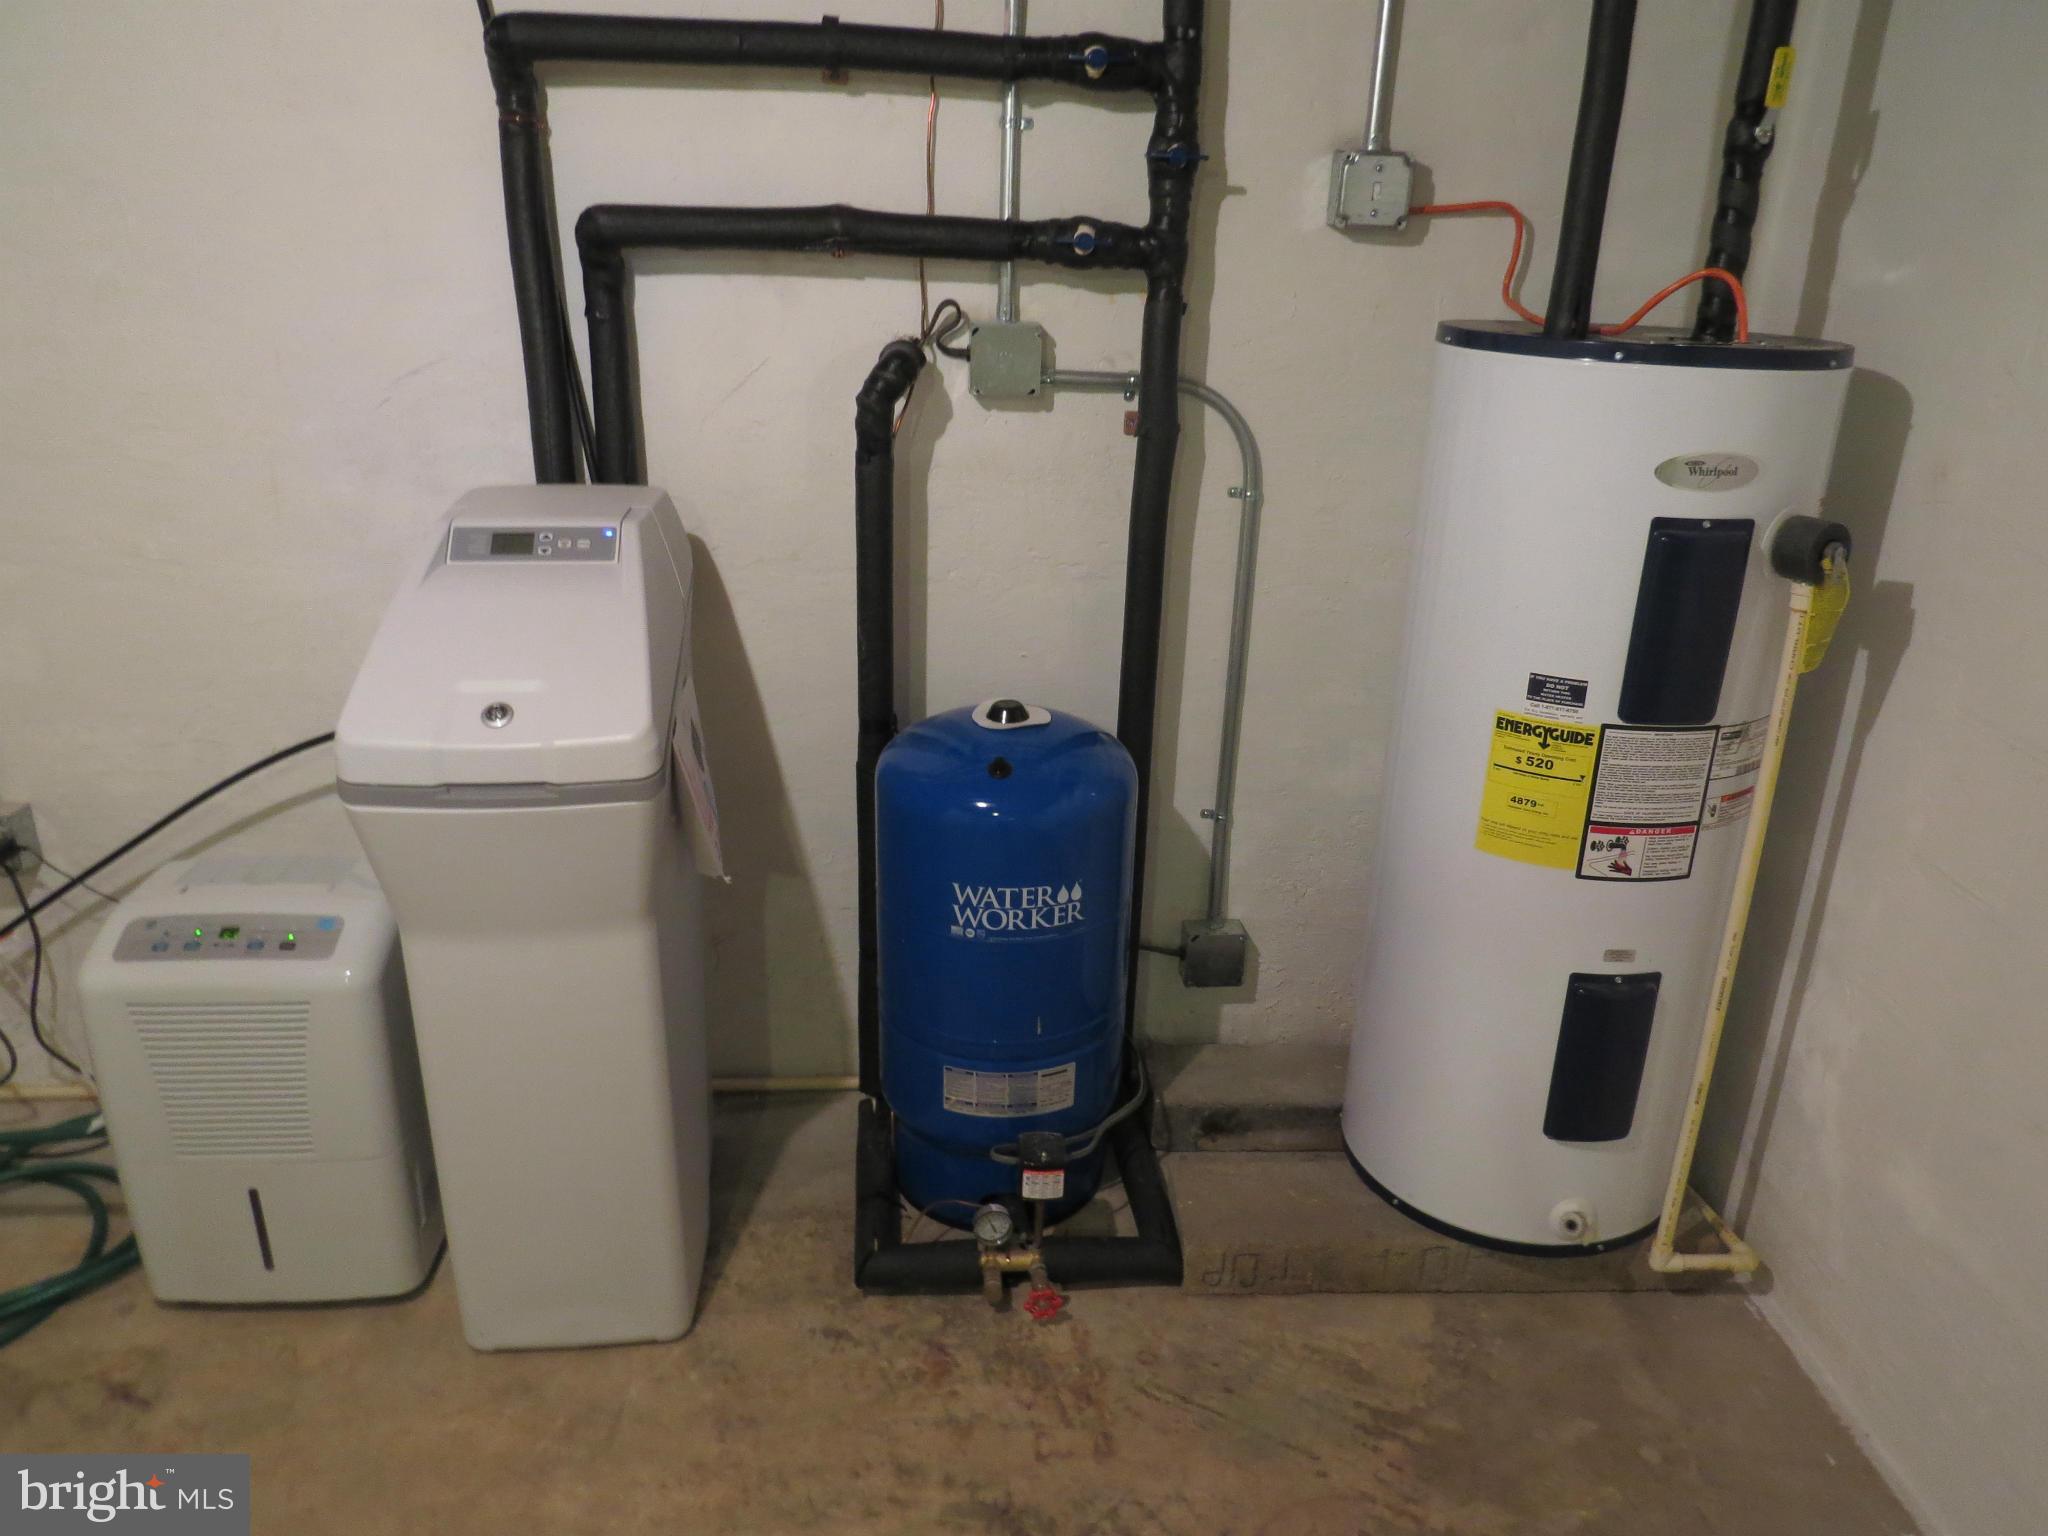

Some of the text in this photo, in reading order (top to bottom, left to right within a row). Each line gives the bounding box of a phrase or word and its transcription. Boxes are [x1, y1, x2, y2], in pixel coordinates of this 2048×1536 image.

[1688, 466, 1738, 479] Whirlpool
[1496, 716, 1595, 748] ENERGYGUIDE
[1515, 756, 1554, 770] $ 520
[1510, 796, 1537, 807] 4879
[952, 882, 1057, 909] WATER
[952, 902, 1086, 931] WORKER
